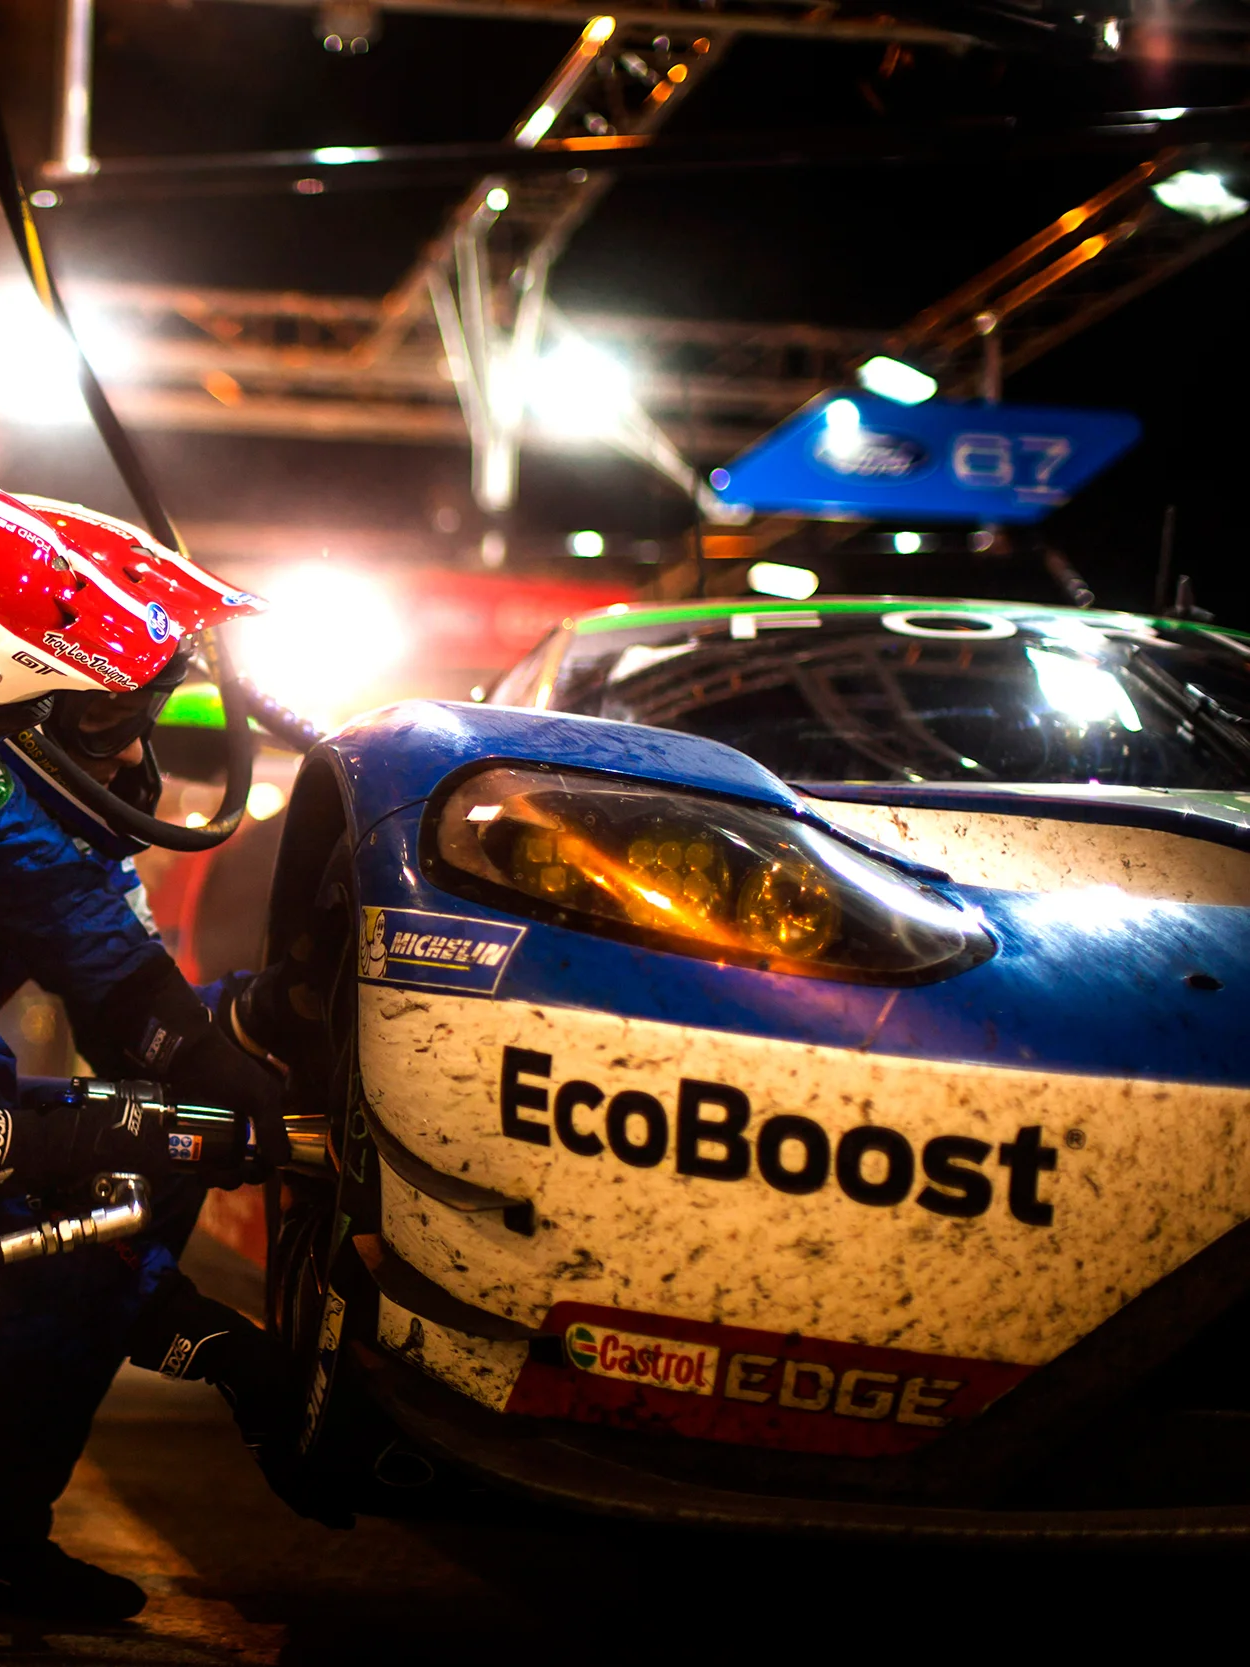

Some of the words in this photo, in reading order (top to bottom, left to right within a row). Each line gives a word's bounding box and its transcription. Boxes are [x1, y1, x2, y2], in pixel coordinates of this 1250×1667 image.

[18, 529, 51, 554] FORD
[11, 650, 68, 676] GT
[44, 632, 68, 657] Troy
[67, 642, 90, 665] Lee
[88, 654, 139, 690] Designs
[390, 931, 509, 967] MICHELIN
[500, 1045, 1058, 1228] EcoBoost
[600, 1335, 707, 1388] Castrol
[724, 1352, 963, 1428] EDGE
